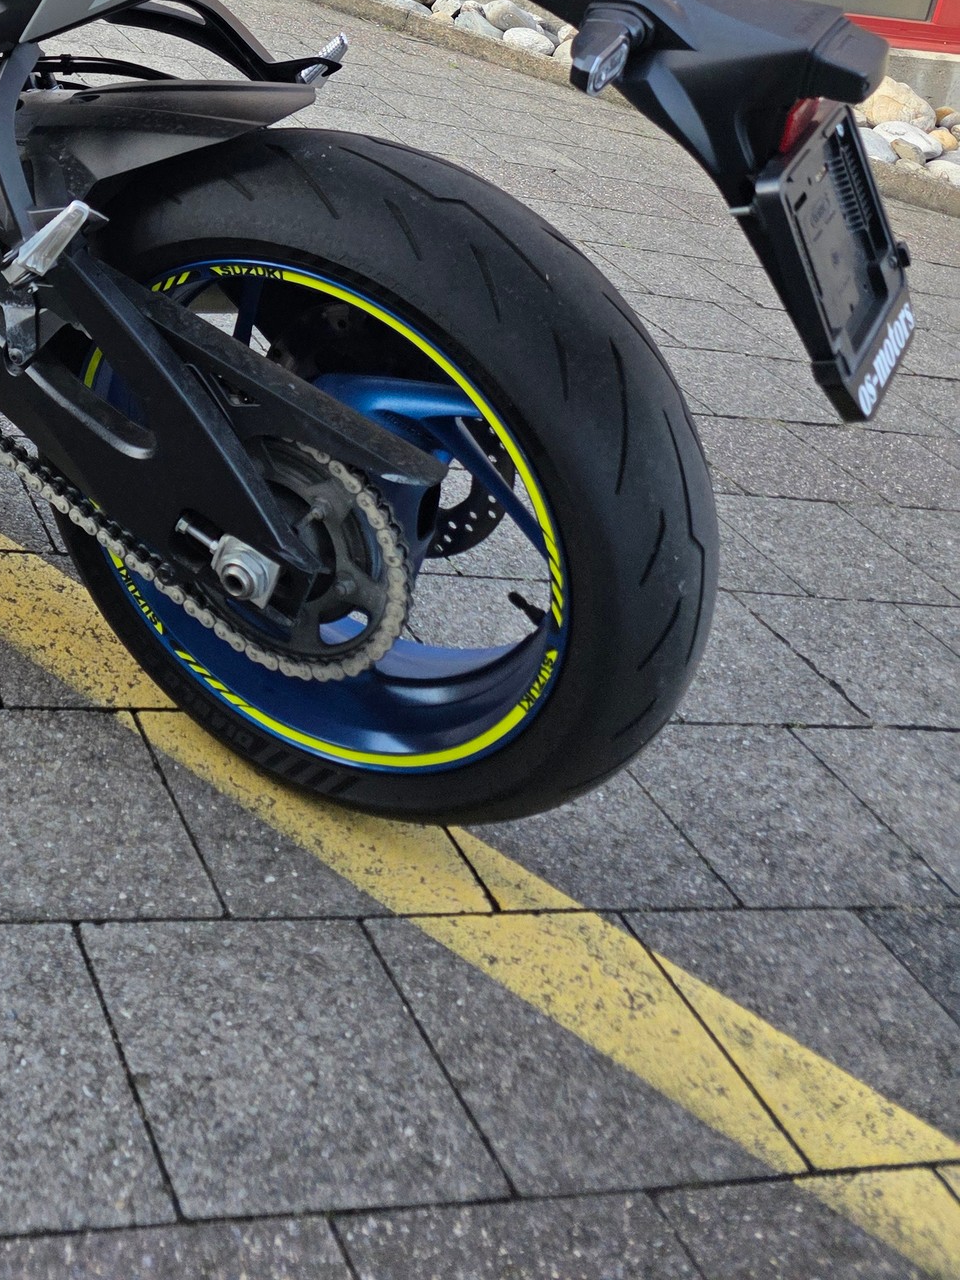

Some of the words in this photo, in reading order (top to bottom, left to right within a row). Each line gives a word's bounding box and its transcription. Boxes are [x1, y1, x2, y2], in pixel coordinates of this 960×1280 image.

[220, 264, 284, 281] SUZUKI
[858, 302, 915, 416] os-motors
[118, 566, 158, 627] SUZUKI
[519, 658, 554, 713] SUZUKI
